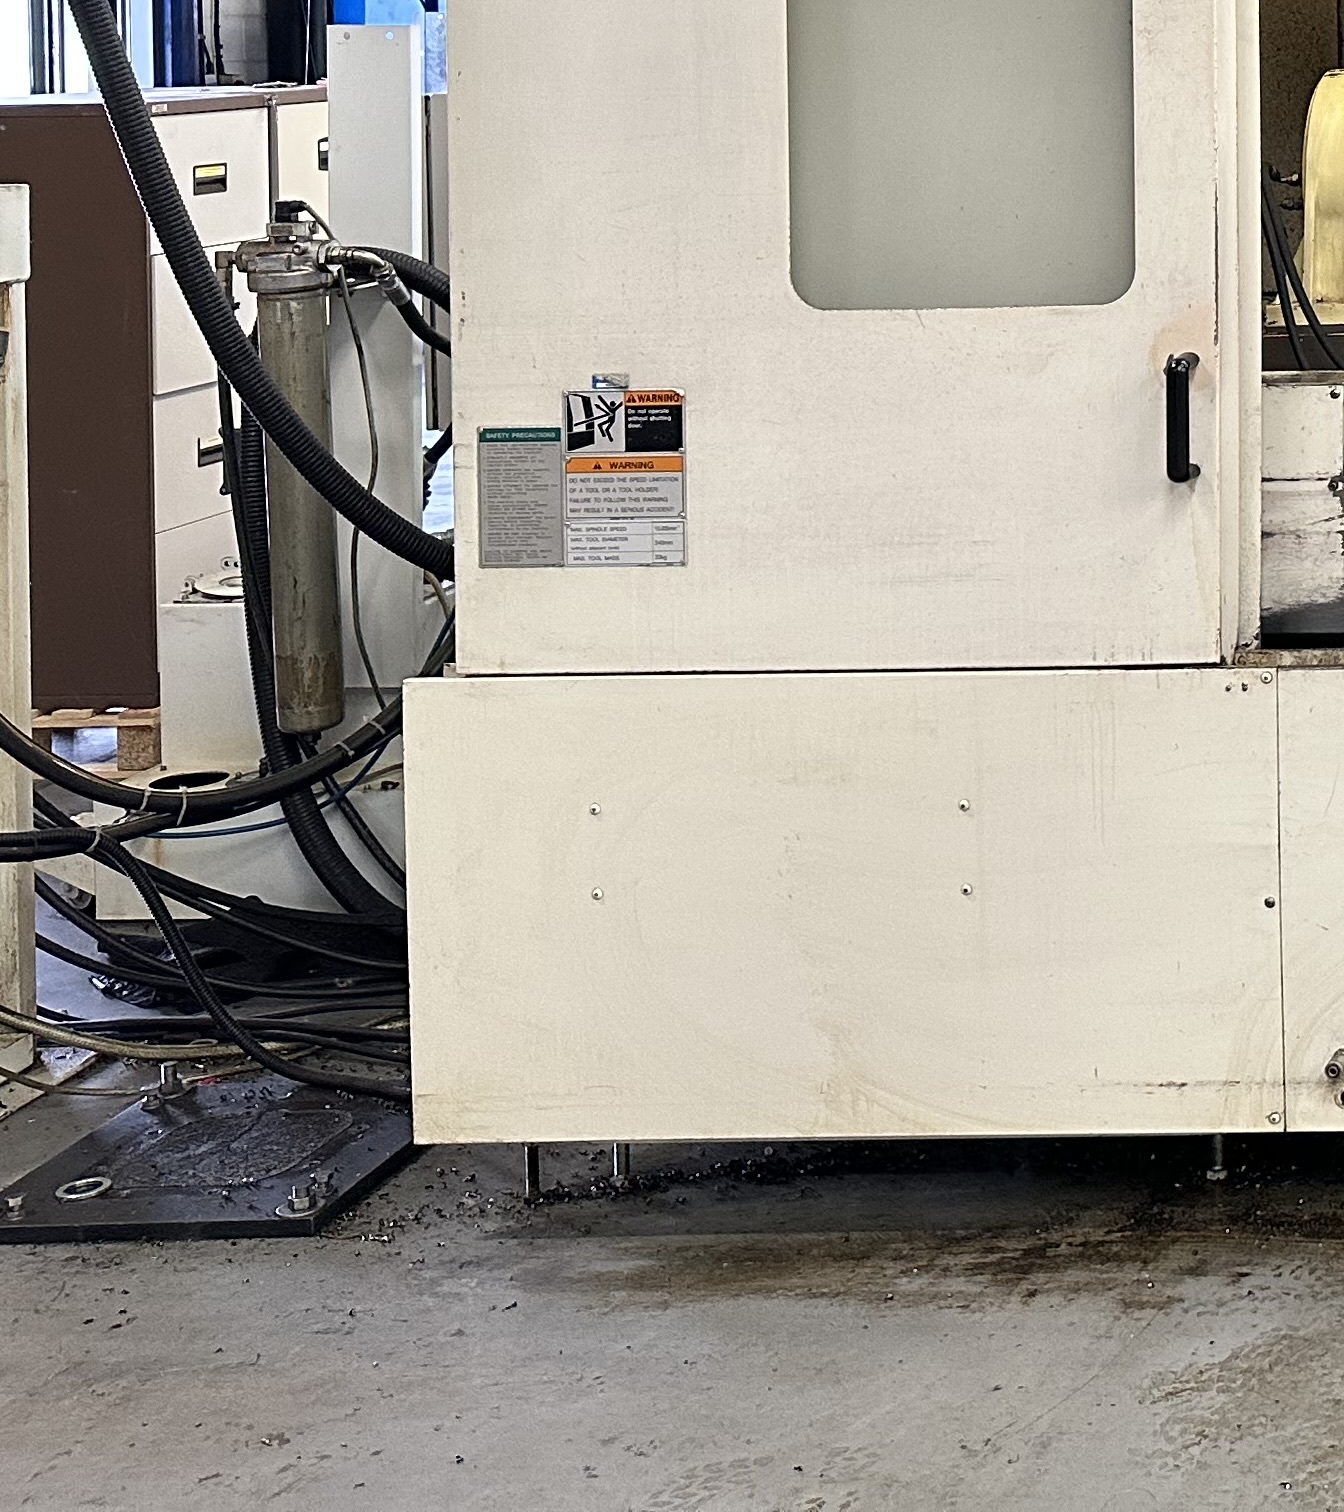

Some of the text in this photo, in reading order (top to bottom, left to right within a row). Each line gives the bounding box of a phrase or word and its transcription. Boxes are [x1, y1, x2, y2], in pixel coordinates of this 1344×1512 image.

[636, 394, 680, 403] WARNING
[511, 431, 556, 439] PRECAUTIONS
[609, 461, 655, 470] WARNING
